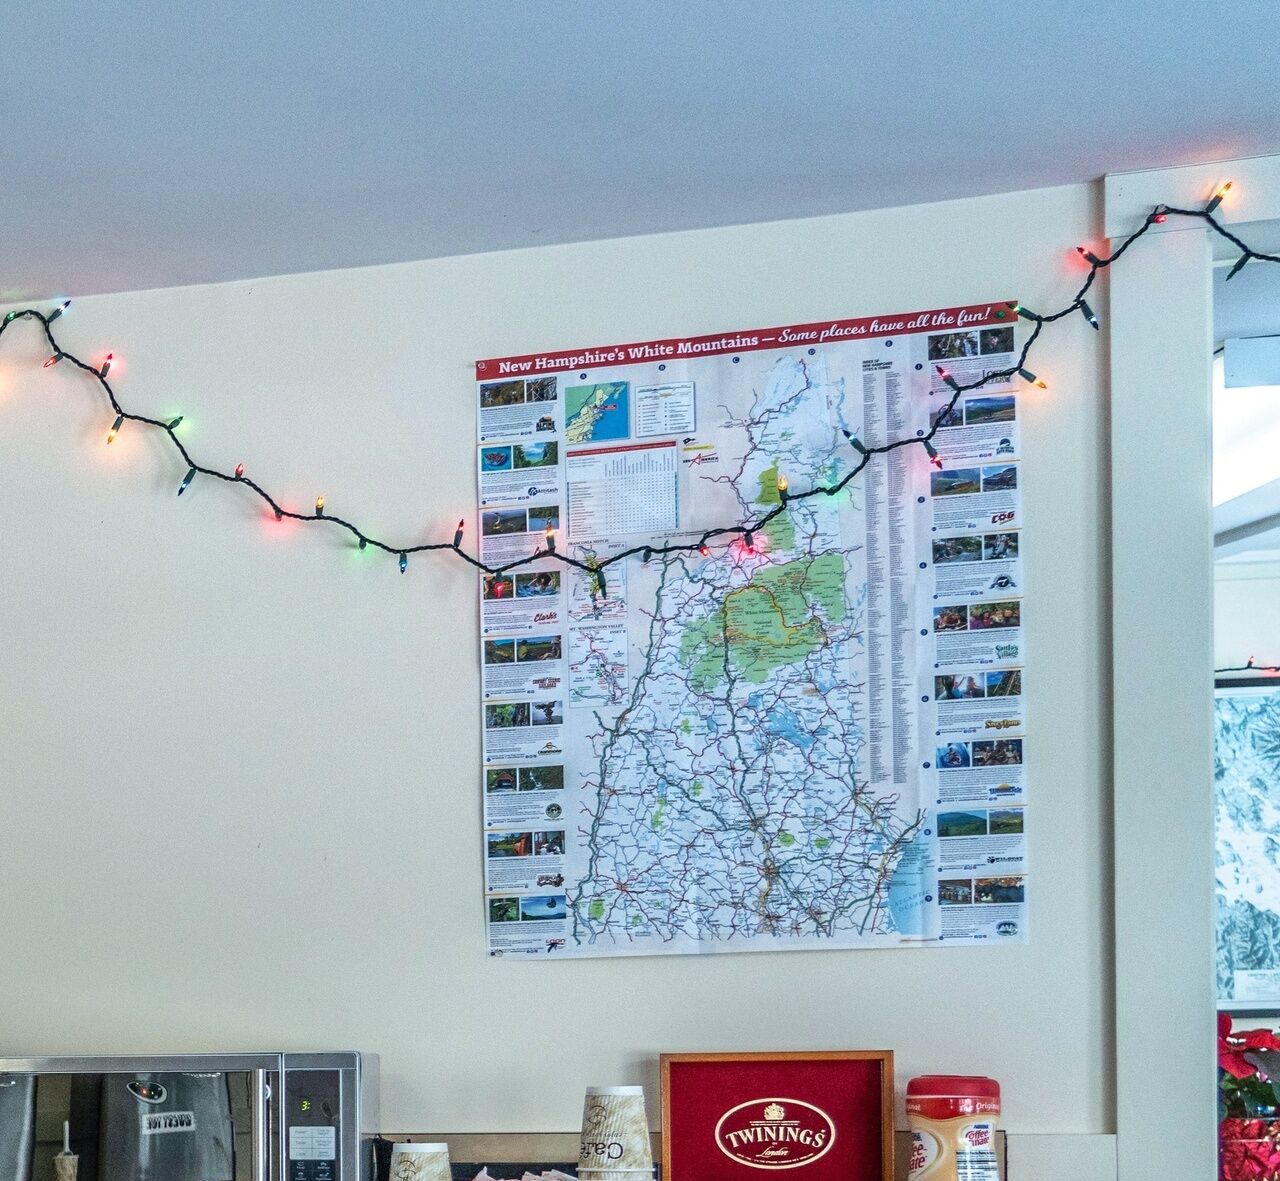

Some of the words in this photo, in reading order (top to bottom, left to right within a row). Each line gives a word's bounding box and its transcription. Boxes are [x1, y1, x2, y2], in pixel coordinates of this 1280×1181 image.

[499, 362, 531, 373] New
[534, 347, 624, 370] Hampshire’s
[628, 343, 673, 359] White
[677, 335, 758, 354] Mountains
[778, 329, 817, 343] Some
[819, 324, 867, 345] places
[869, 319, 903, 333] have
[907, 315, 930, 328] all
[931, 312, 955, 326] the
[956, 307, 991, 327] fun!
[725, 1126, 826, 1149] TWININGS
[755, 1146, 789, 1158] London
